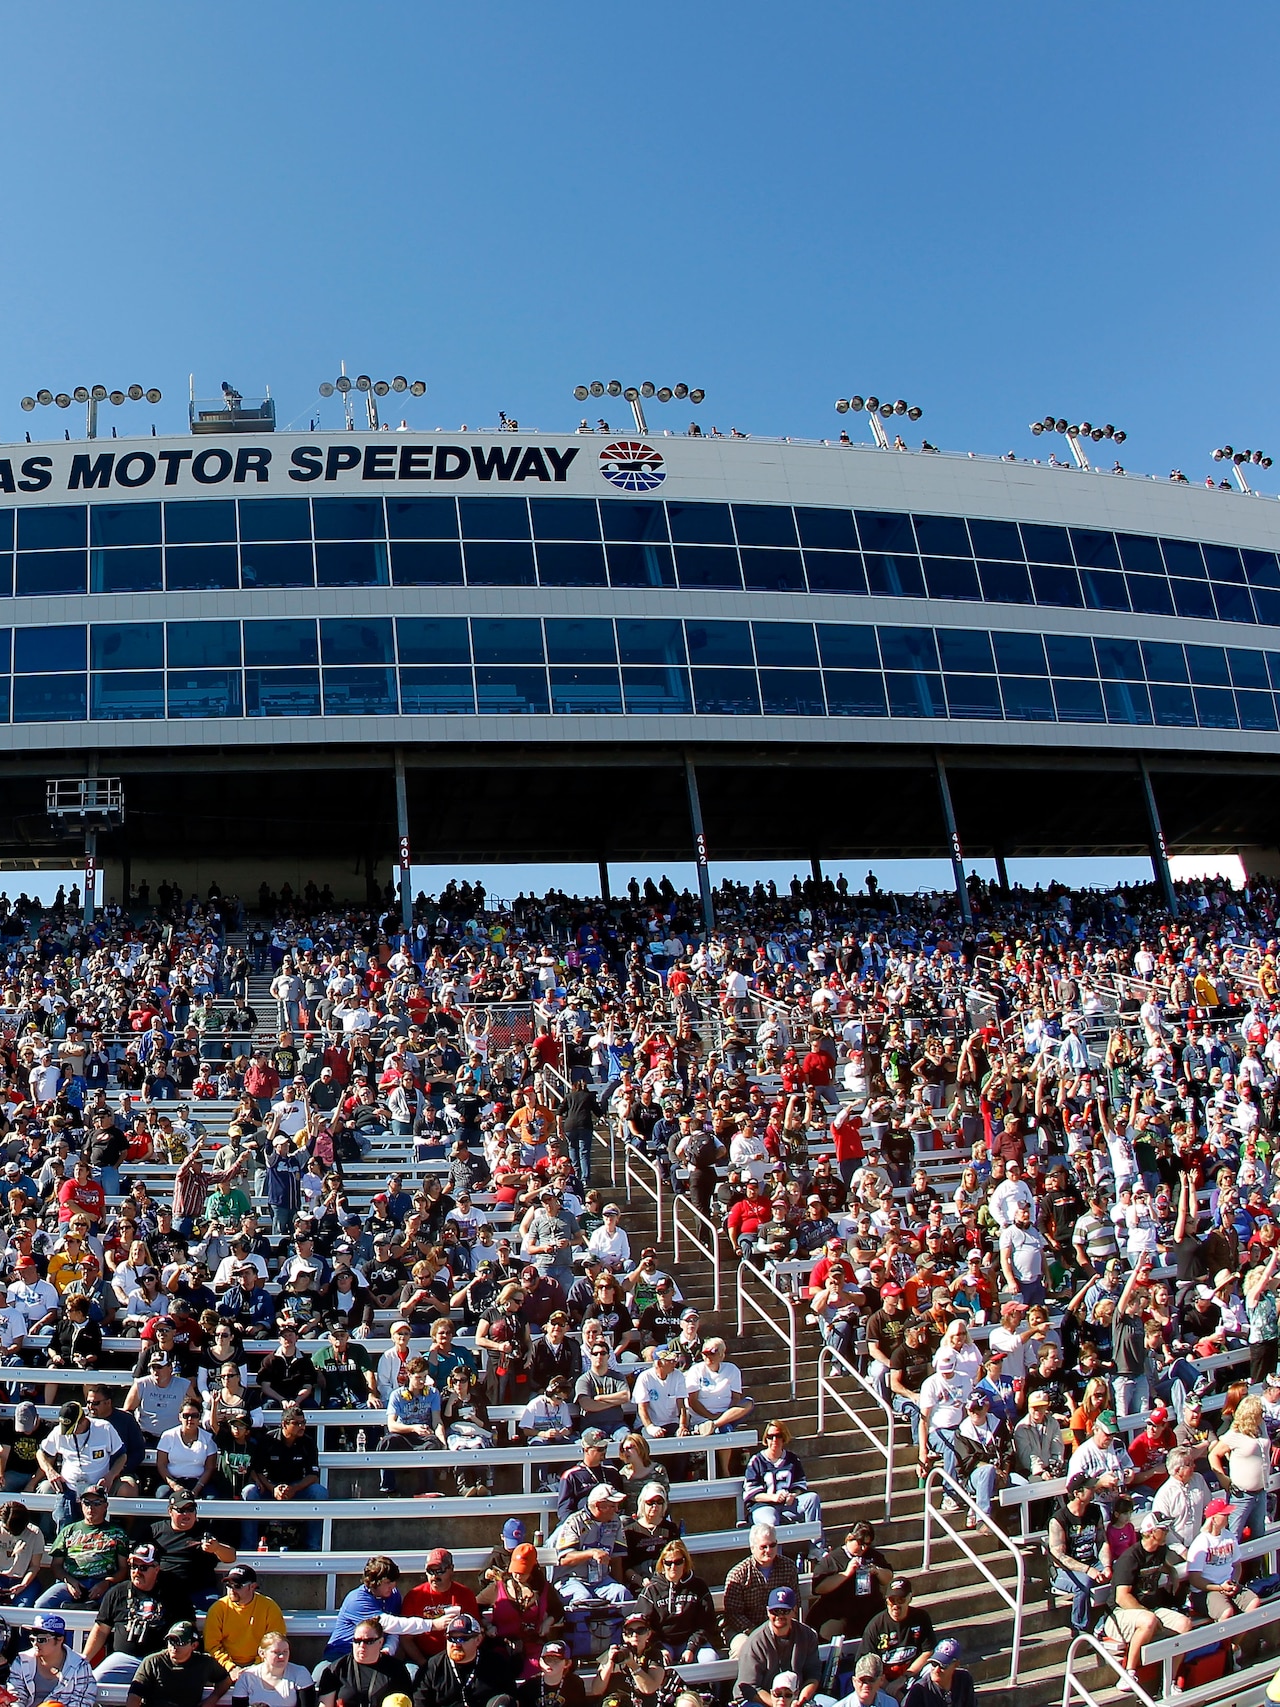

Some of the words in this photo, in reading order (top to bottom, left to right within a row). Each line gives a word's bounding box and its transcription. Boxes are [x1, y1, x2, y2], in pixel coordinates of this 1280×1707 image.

[67, 446, 272, 489] MOTOR
[287, 445, 580, 483] SPEEDWAY
[400, 837, 409, 869] 401
[696, 835, 707, 865] 402
[951, 833, 962, 861] 403
[86, 857, 94, 889] 101
[149, 1392, 176, 1400] AMERICA
[775, 1591, 786, 1603] T
